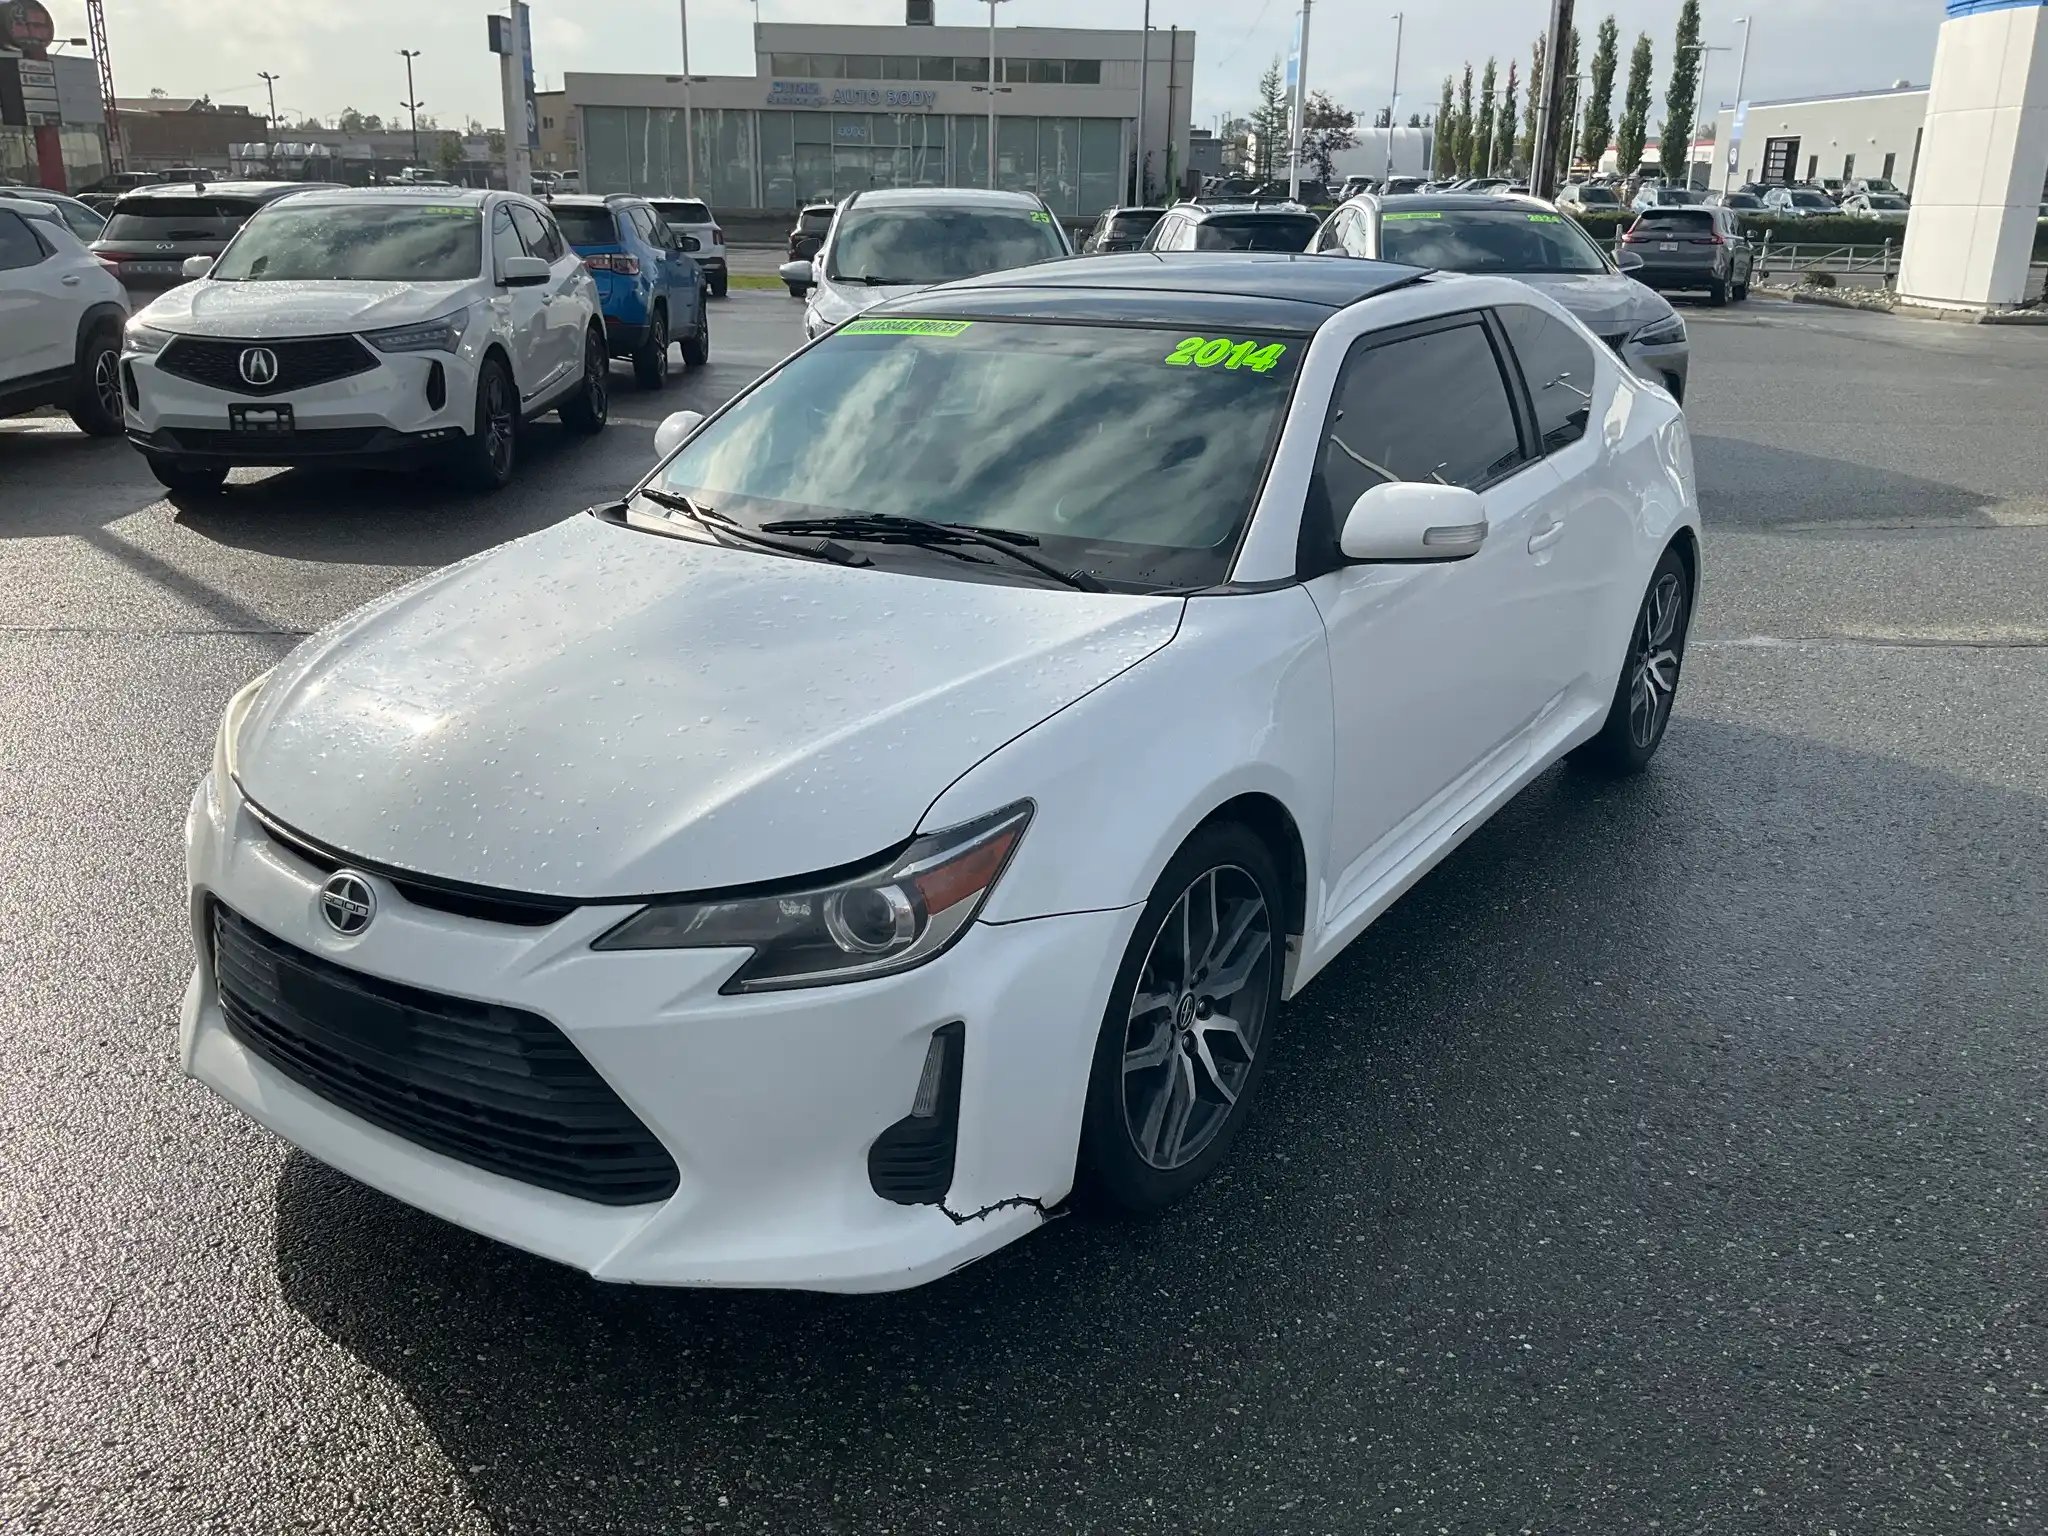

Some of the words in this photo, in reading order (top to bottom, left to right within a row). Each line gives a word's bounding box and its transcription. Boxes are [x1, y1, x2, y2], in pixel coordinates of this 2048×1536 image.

[831, 88, 880, 106] AUTO
[886, 90, 938, 107] BODY
[1030, 211, 1050, 223] 25
[842, 320, 919, 332] WHOLESALE
[913, 321, 966, 334] PRICED
[1165, 337, 1287, 372] 2014
